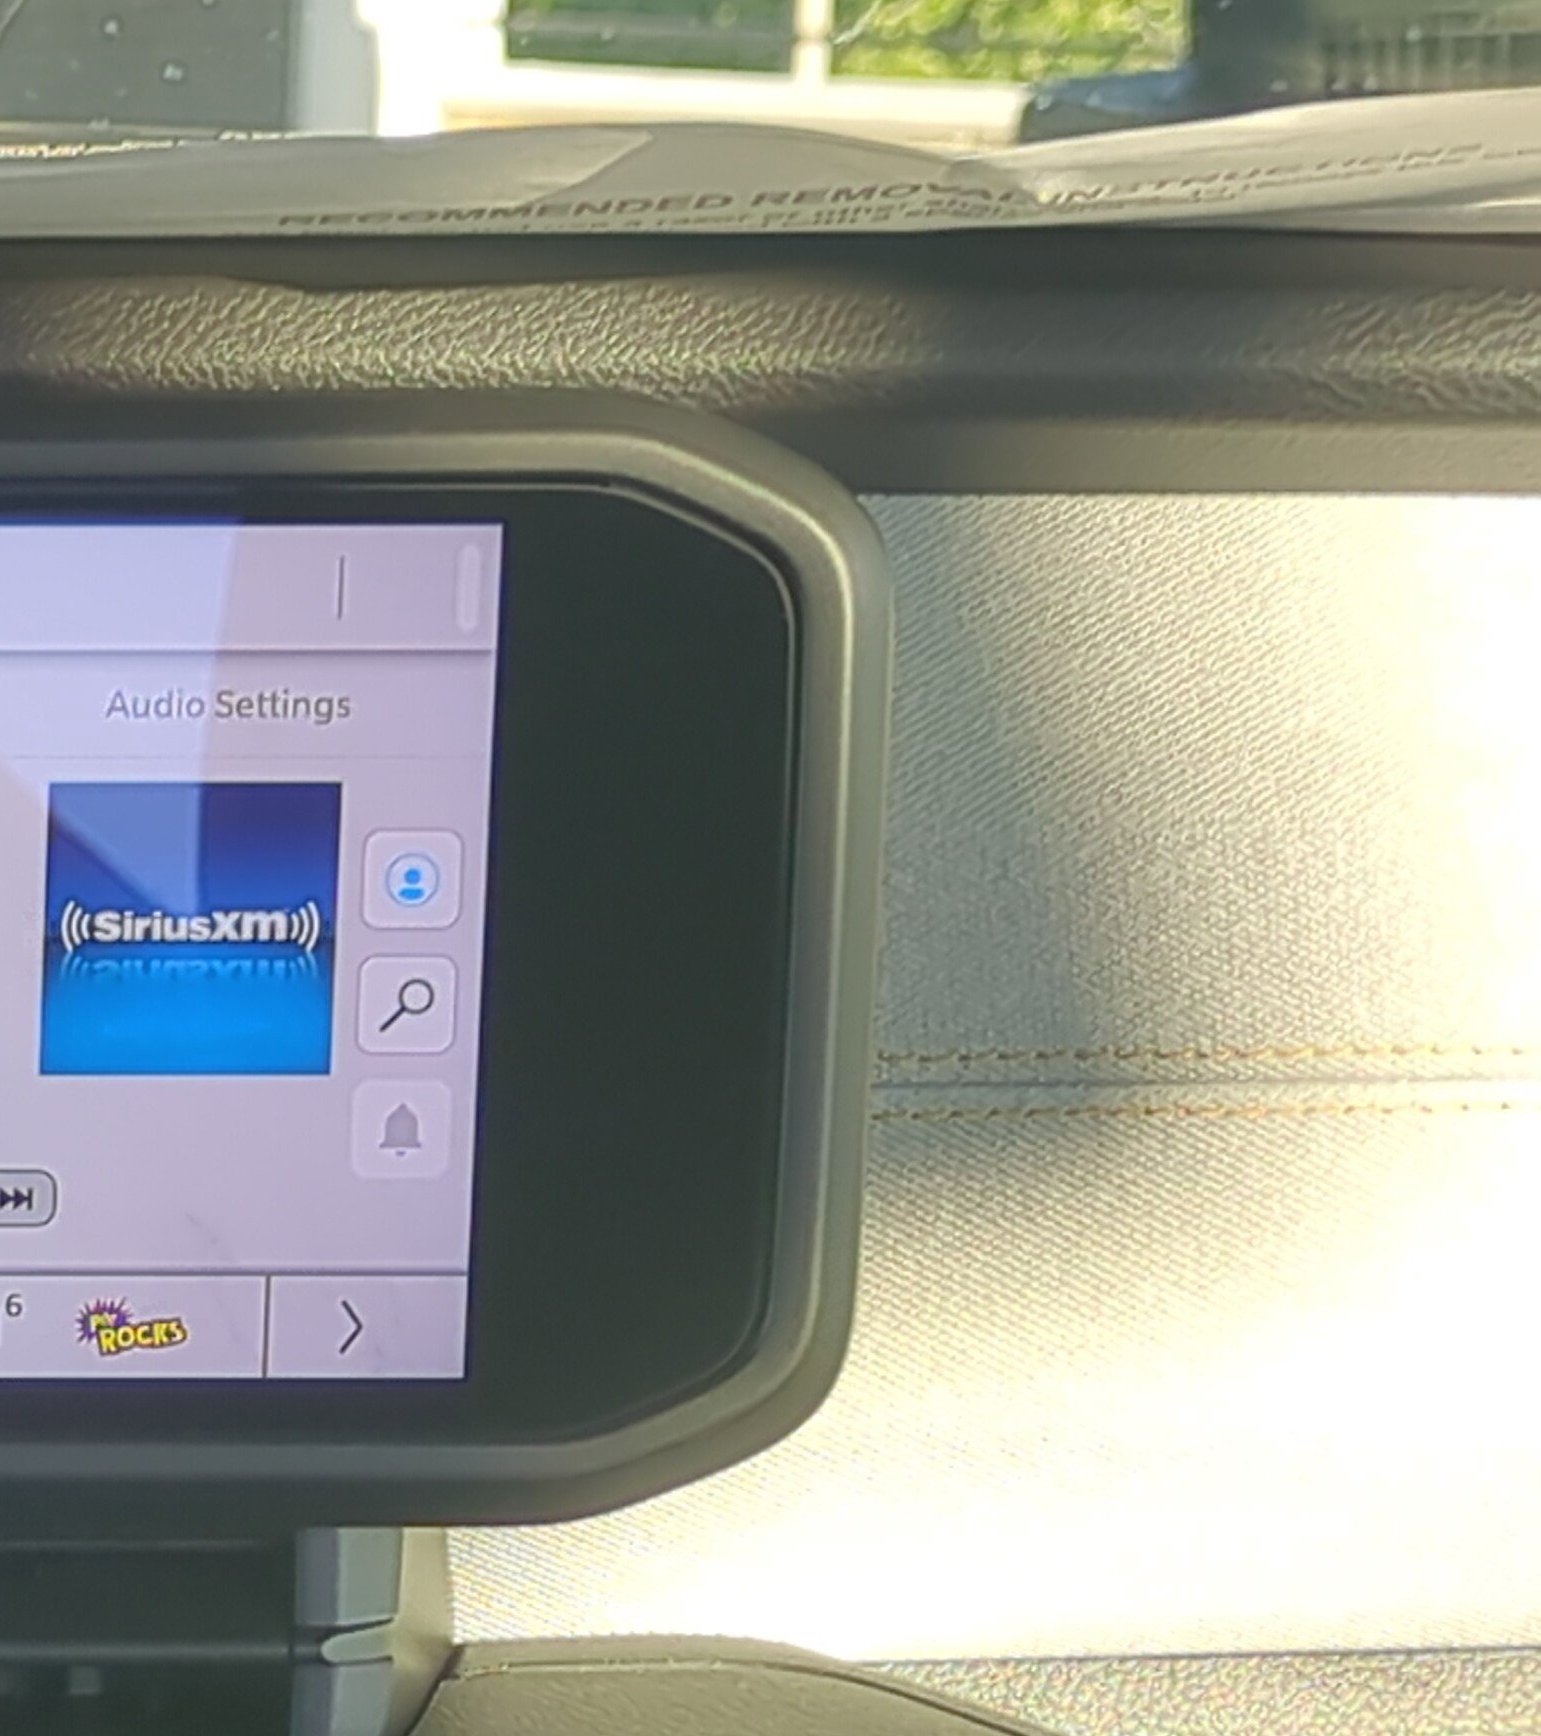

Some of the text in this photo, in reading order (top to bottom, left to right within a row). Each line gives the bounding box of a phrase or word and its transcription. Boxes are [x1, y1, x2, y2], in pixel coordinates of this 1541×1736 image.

[105, 688, 352, 726] Audio Settings
[5, 1293, 23, 1318] 6
[98, 1318, 187, 1355] ROCKS
